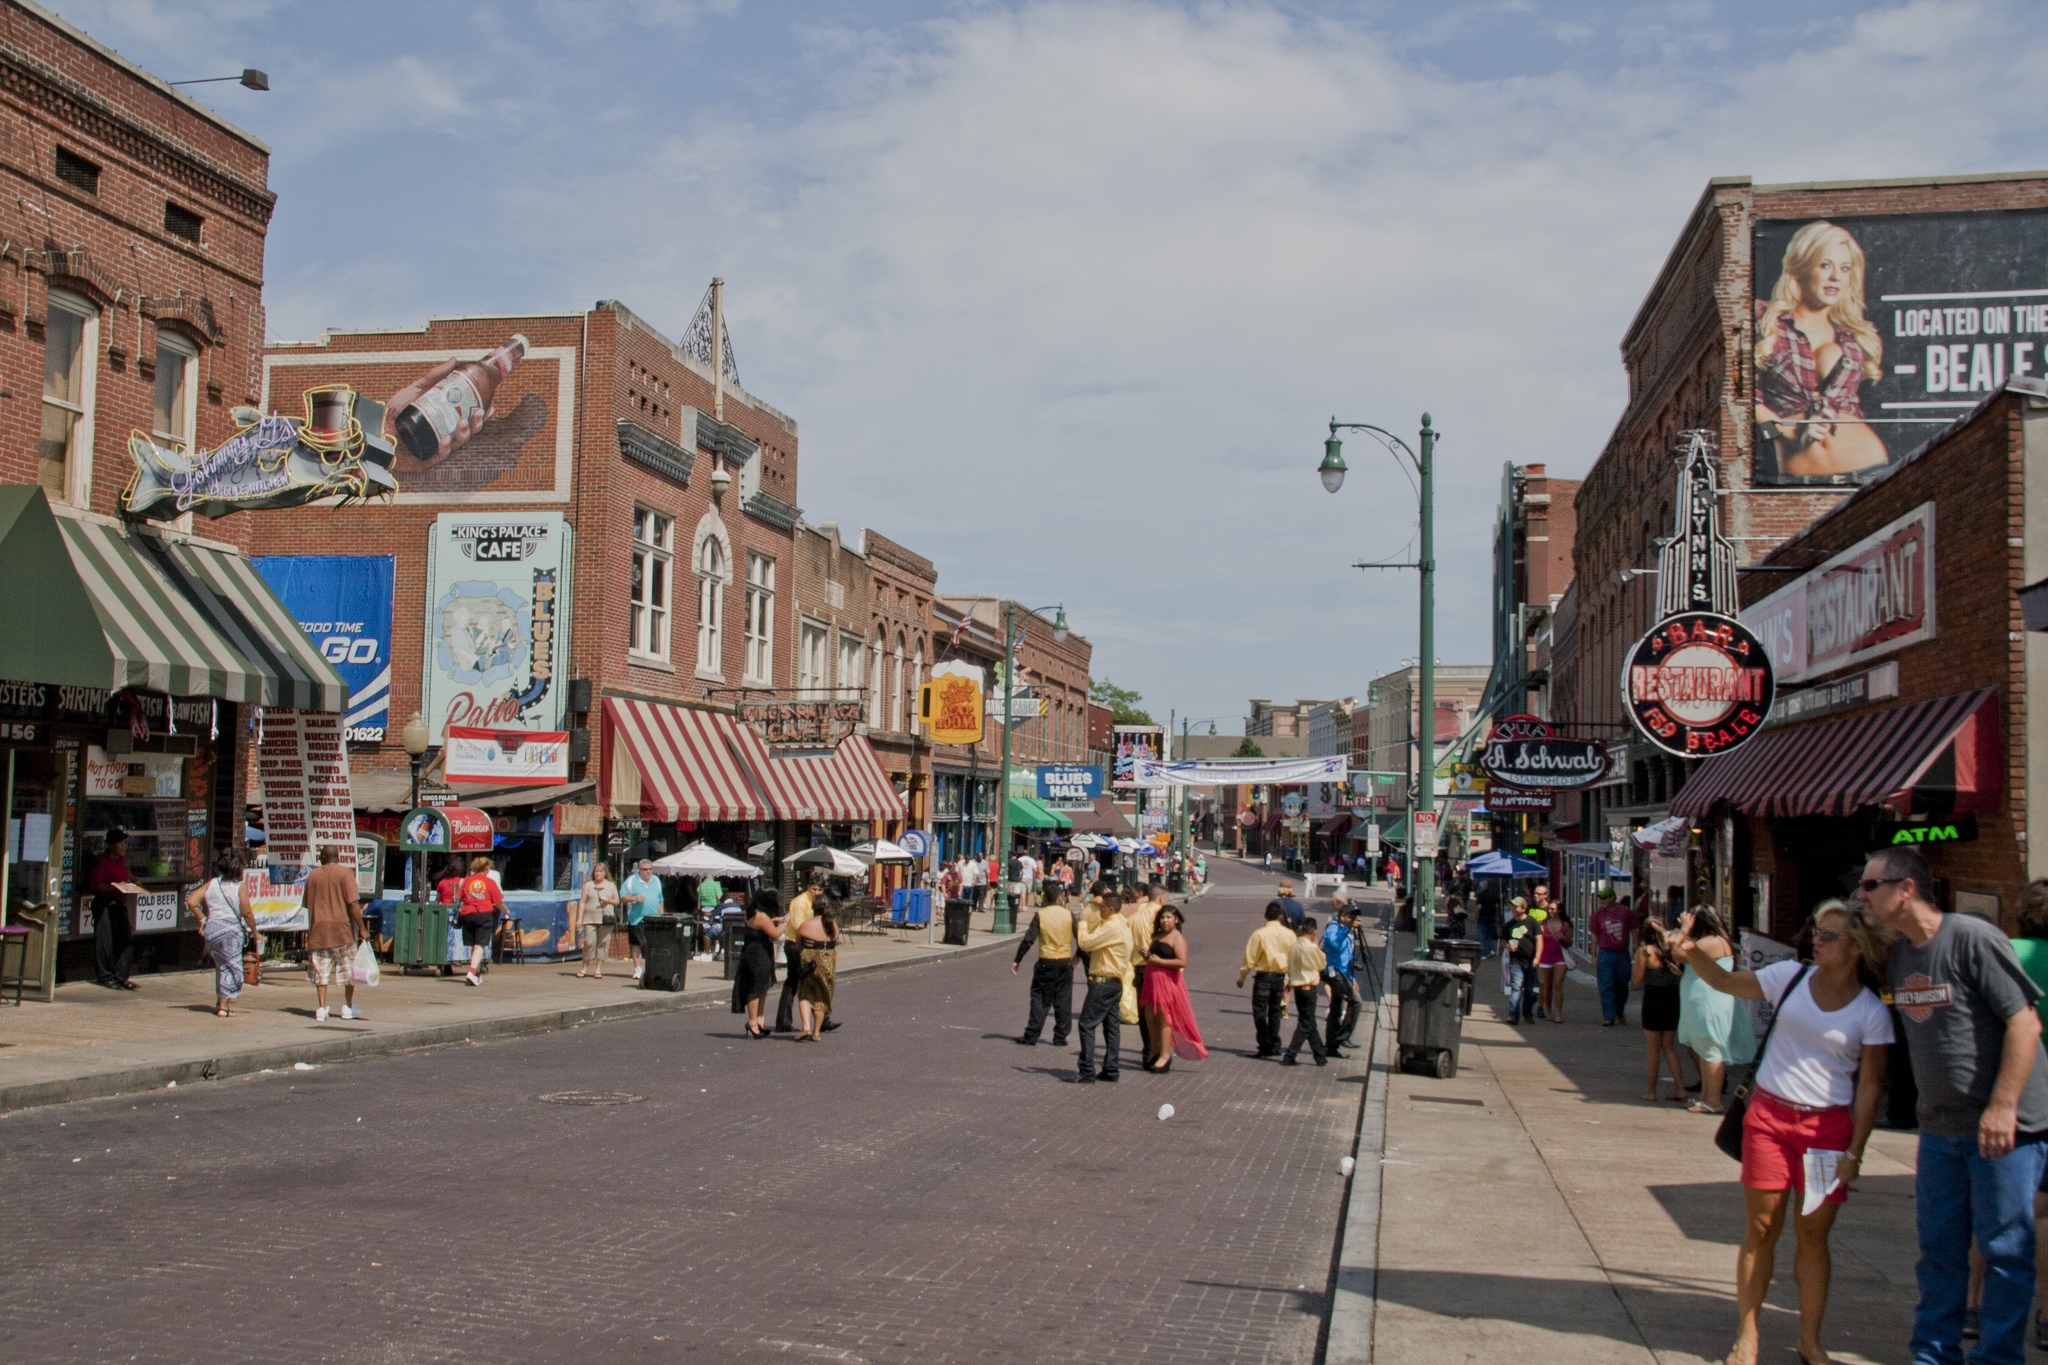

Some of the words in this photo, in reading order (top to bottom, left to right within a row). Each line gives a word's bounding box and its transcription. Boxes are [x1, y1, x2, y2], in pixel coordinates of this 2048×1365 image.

[1894, 307, 1980, 338] LOCATED
[1982, 306, 2011, 335] ON
[2013, 304, 2048, 334] THE
[458, 526, 497, 538] KING'S
[500, 526, 542, 538] PALACE
[477, 542, 521, 558] CAFE
[1807, 536, 1919, 656] RESTAURANT
[335, 622, 364, 633] TIME
[532, 581, 553, 680] BLUES
[1667, 619, 1735, 647] BAR
[1631, 667, 1766, 701] RESTAURANT
[796, 703, 859, 719] PALACE
[1013, 699, 1038, 716] CARGO
[441, 691, 519, 737] Patio
[305, 719, 337, 728] SALADS
[935, 715, 978, 730] ROOM
[1, 723, 36, 741] 156
[767, 722, 833, 740] CAFE
[1644, 706, 1677, 739] 159
[1687, 709, 1759, 751] BEALE
[304, 733, 341, 741] BUCKET
[345, 727, 383, 742] 01622
[261, 748, 298, 756] NACHOS
[308, 742, 340, 751] HOUSE
[307, 753, 343, 761] GREENS
[1487, 744, 1512, 769] A.
[1515, 744, 1601, 770] Schwab
[88, 759, 104, 777] HOT
[104, 761, 128, 777] FOOD
[260, 760, 278, 768] DEEP
[313, 765, 340, 774] FRIED
[95, 778, 106, 789] TO
[107, 778, 120, 789] GO
[308, 775, 348, 784] PICKLES
[1044, 772, 1093, 785] BLUES
[1509, 774, 1571, 786] ESTABLISHED
[264, 781, 301, 789] VOODOO
[265, 789, 304, 798] CHICKEN
[309, 788, 330, 796] MARDI
[332, 788, 350, 797] GRAS
[1049, 785, 1087, 798] HALL
[266, 802, 305, 810] PO-BOYS
[310, 797, 337, 806] CHEESE
[339, 797, 351, 806] DIP
[1505, 797, 1552, 806] ATTITUDE
[268, 813, 305, 821] CREOLE
[311, 811, 352, 819] PEPPADEW
[1418, 813, 1433, 822] NO
[268, 822, 306, 830] WRAPS
[313, 821, 352, 830] BRISKET
[451, 818, 490, 835] Budweiser
[616, 820, 642, 829] ATM
[269, 833, 307, 841] GUMBO
[316, 831, 351, 840] PO-BOY
[1891, 824, 1959, 845] ATM
[280, 852, 300, 861] STEW
[138, 894, 156, 907] COLD
[157, 893, 177, 906] BEER
[140, 909, 152, 921] TO
[157, 909, 172, 921] GO
